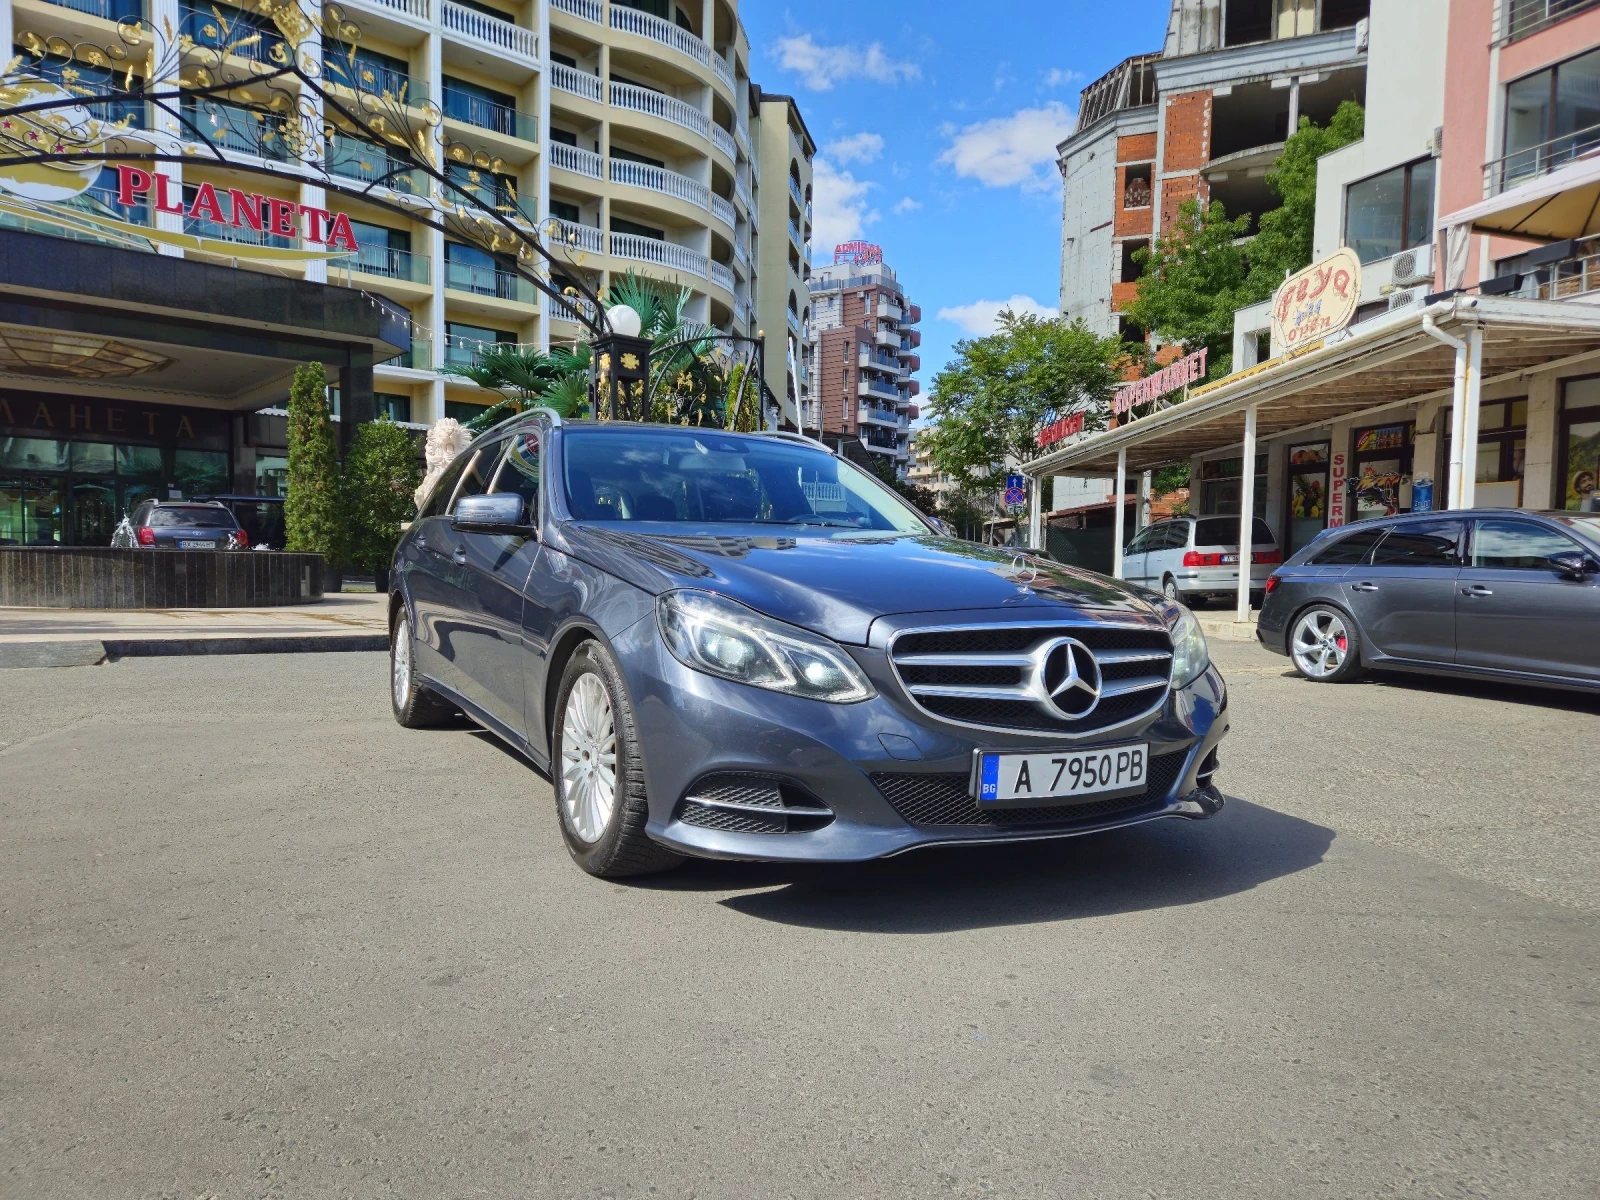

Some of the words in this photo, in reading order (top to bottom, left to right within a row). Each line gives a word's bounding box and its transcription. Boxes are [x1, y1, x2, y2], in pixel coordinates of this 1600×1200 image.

[116, 164, 359, 252] PLANETA
[835, 242, 882, 253] ADMIRAL
[1013, 760, 1032, 793] A
[982, 784, 996, 794] BG
